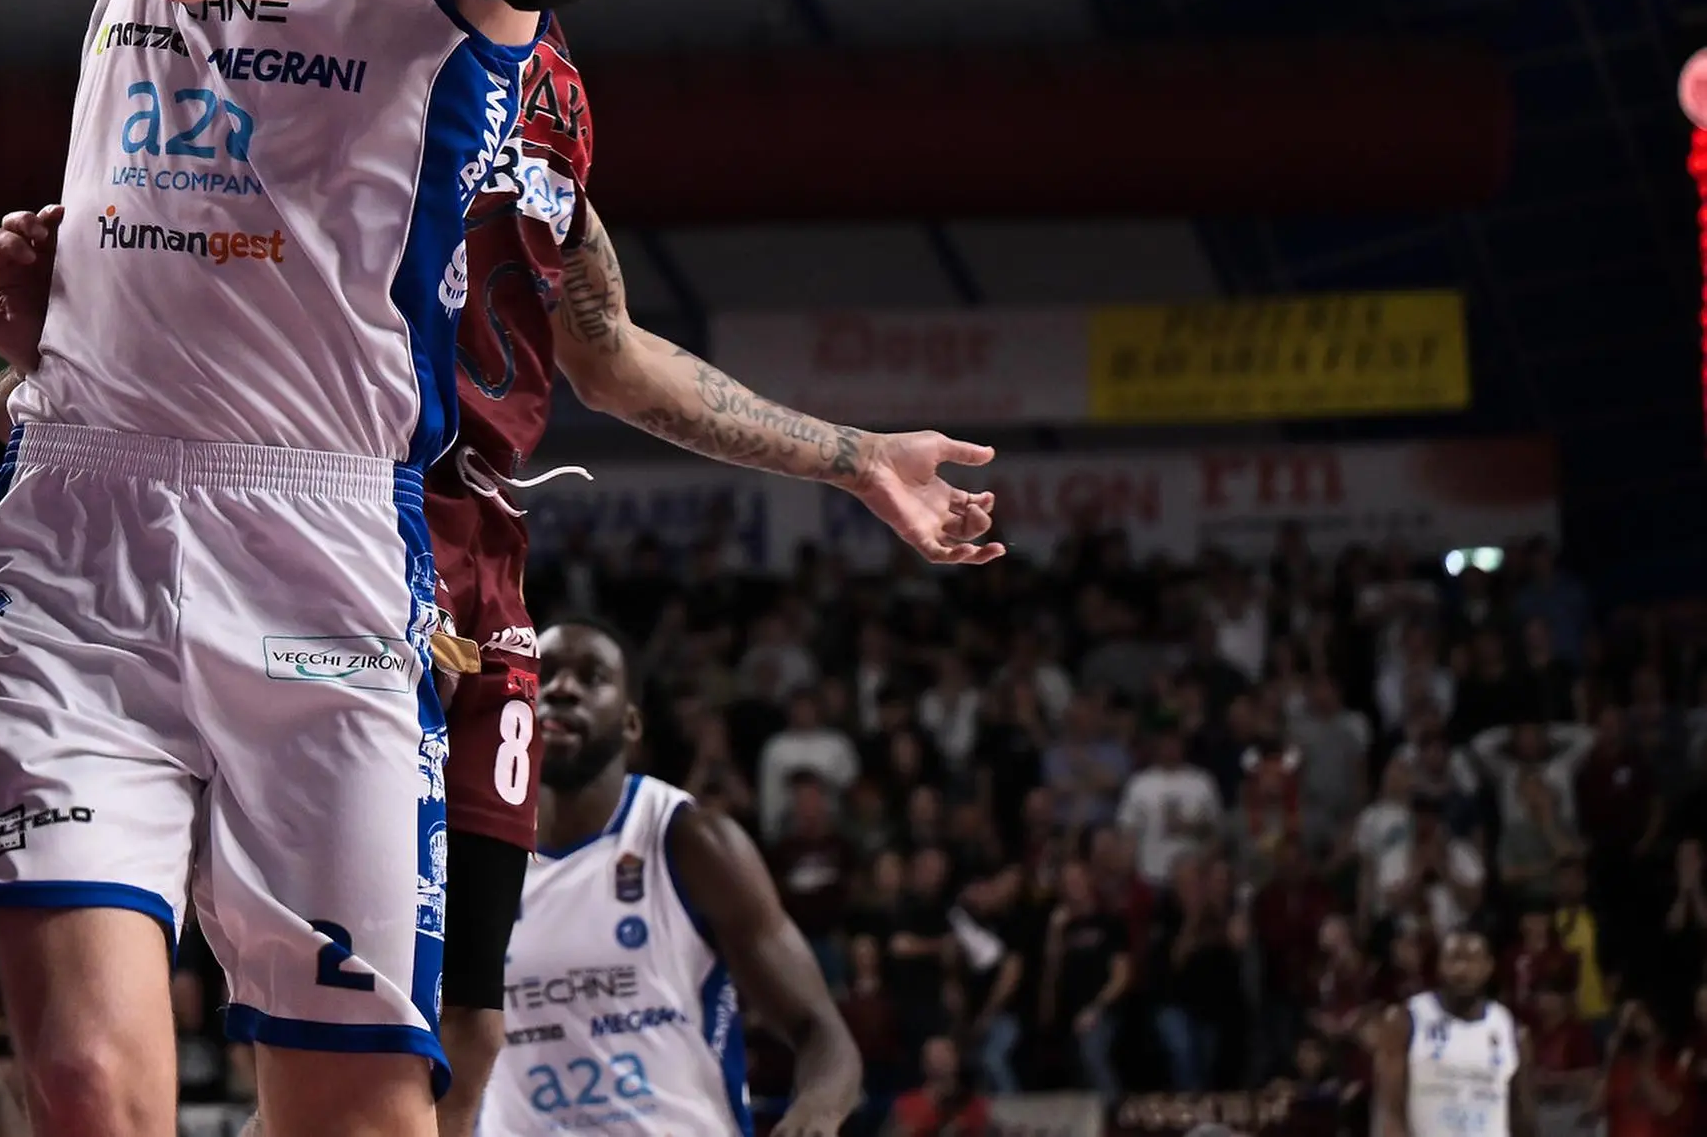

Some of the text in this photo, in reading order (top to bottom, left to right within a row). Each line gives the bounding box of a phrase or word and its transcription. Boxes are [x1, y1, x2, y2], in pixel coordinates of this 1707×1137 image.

[98, 205, 286, 264] Humangest
[273, 651, 407, 672] VECCHI ZIRONI
[494, 700, 533, 805] 8
[315, 919, 375, 992] 2
[528, 1052, 653, 1113] a2a
